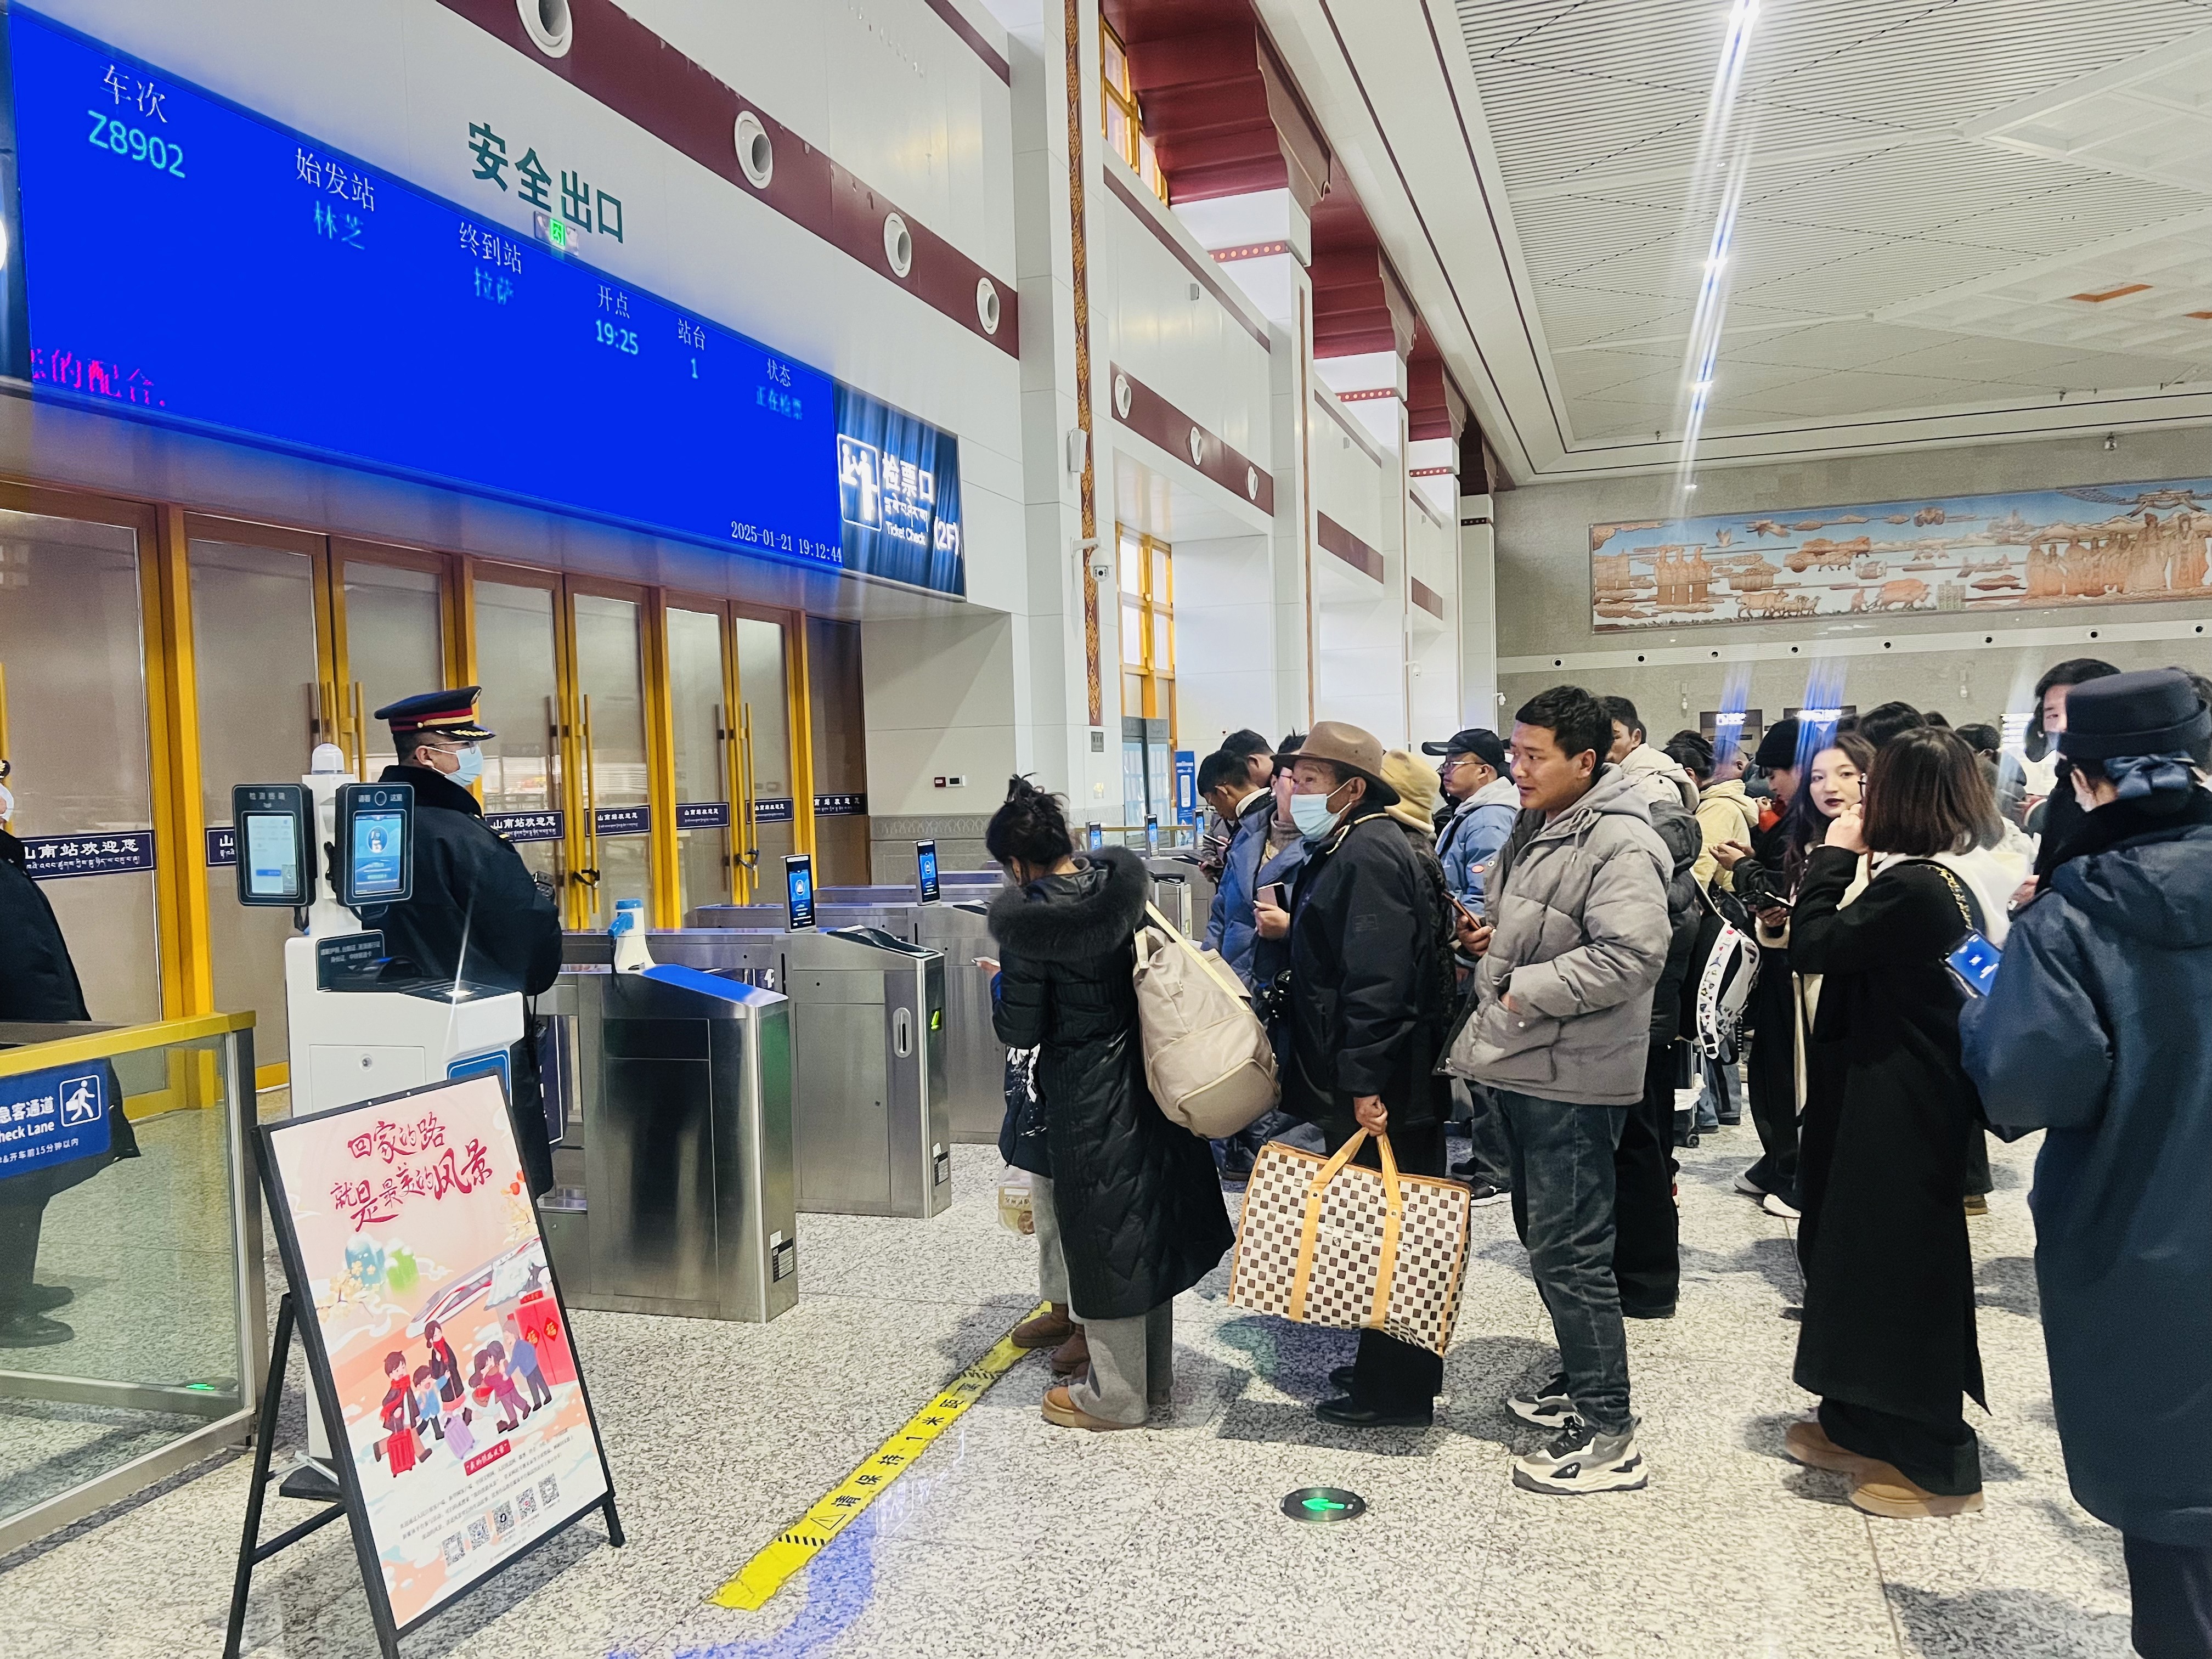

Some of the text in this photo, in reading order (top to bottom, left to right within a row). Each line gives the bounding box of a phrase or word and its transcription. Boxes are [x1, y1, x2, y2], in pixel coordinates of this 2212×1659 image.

[99, 65, 168, 123] 车次
[88, 110, 186, 178] Z8902
[295, 148, 375, 212] 始发站
[469, 122, 623, 244] 安全出口
[313, 200, 365, 250] 林芝
[459, 221, 522, 274] 终到站
[473, 267, 515, 305] 拉萨
[597, 285, 630, 319] 开点
[595, 320, 639, 356] 19:25
[678, 318, 707, 352] 站台
[690, 358, 699, 380] 1
[766, 358, 792, 388] 状态
[882, 451, 933, 504] 检票口
[731, 520, 843, 564] 2025-01-21 19:12:44
[885, 521, 927, 546] Ticket Check
[933, 516, 960, 555] (2F)
[24, 838, 139, 859] 山南站欢迎您
[219, 834, 234, 847] 山
[0, 1096, 54, 1124] 急客通道
[27, 1121, 55, 1137] Lane
[347, 1111, 445, 1164] 回家的路
[330, 1138, 493, 1232] 就是最美的风景
